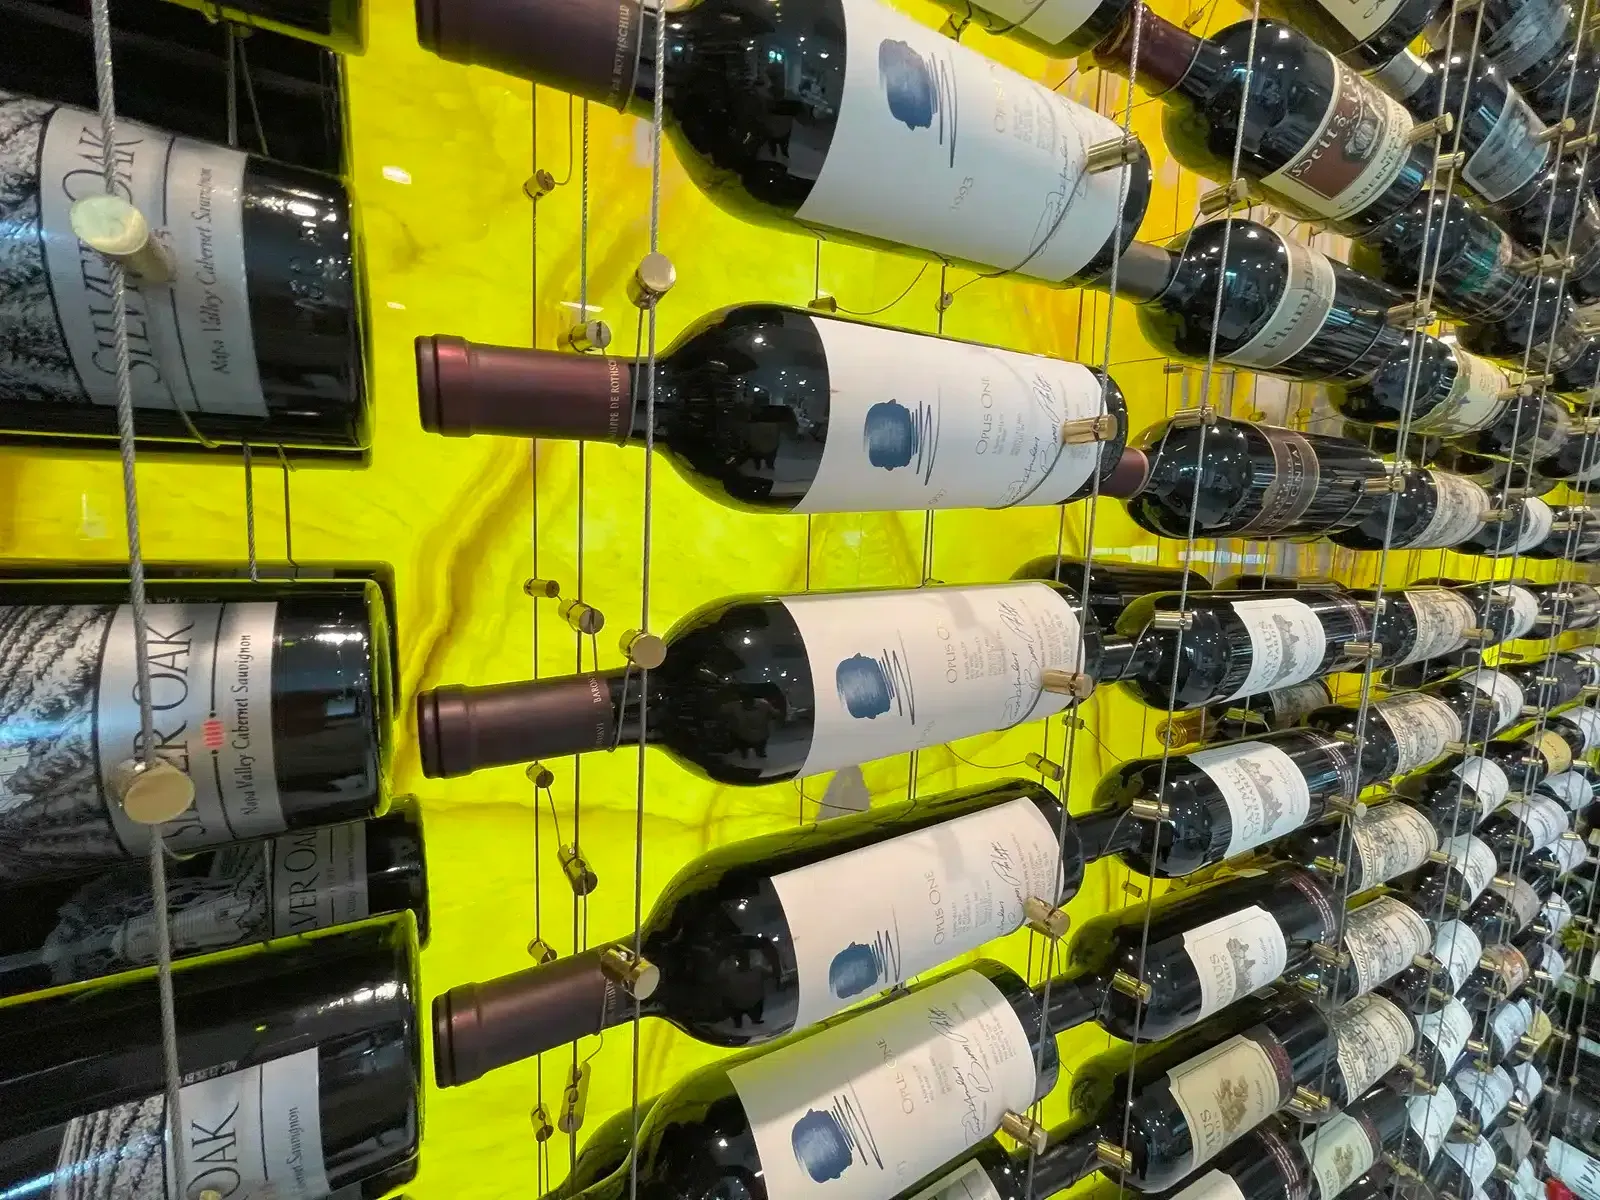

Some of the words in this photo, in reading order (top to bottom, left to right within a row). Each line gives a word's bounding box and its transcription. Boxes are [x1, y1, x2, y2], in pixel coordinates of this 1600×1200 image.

[975, 413, 992, 455] OPUS
[132, 621, 195, 711] OAK
[231, 632, 255, 693] Sauvignon
[588, 676, 602, 704] BARON
[231, 698, 252, 750] Cabernet
[233, 754, 255, 789] Valley
[924, 871, 941, 906] ONE
[933, 908, 945, 945] OPUS
[896, 1072, 914, 1115] OPUS
